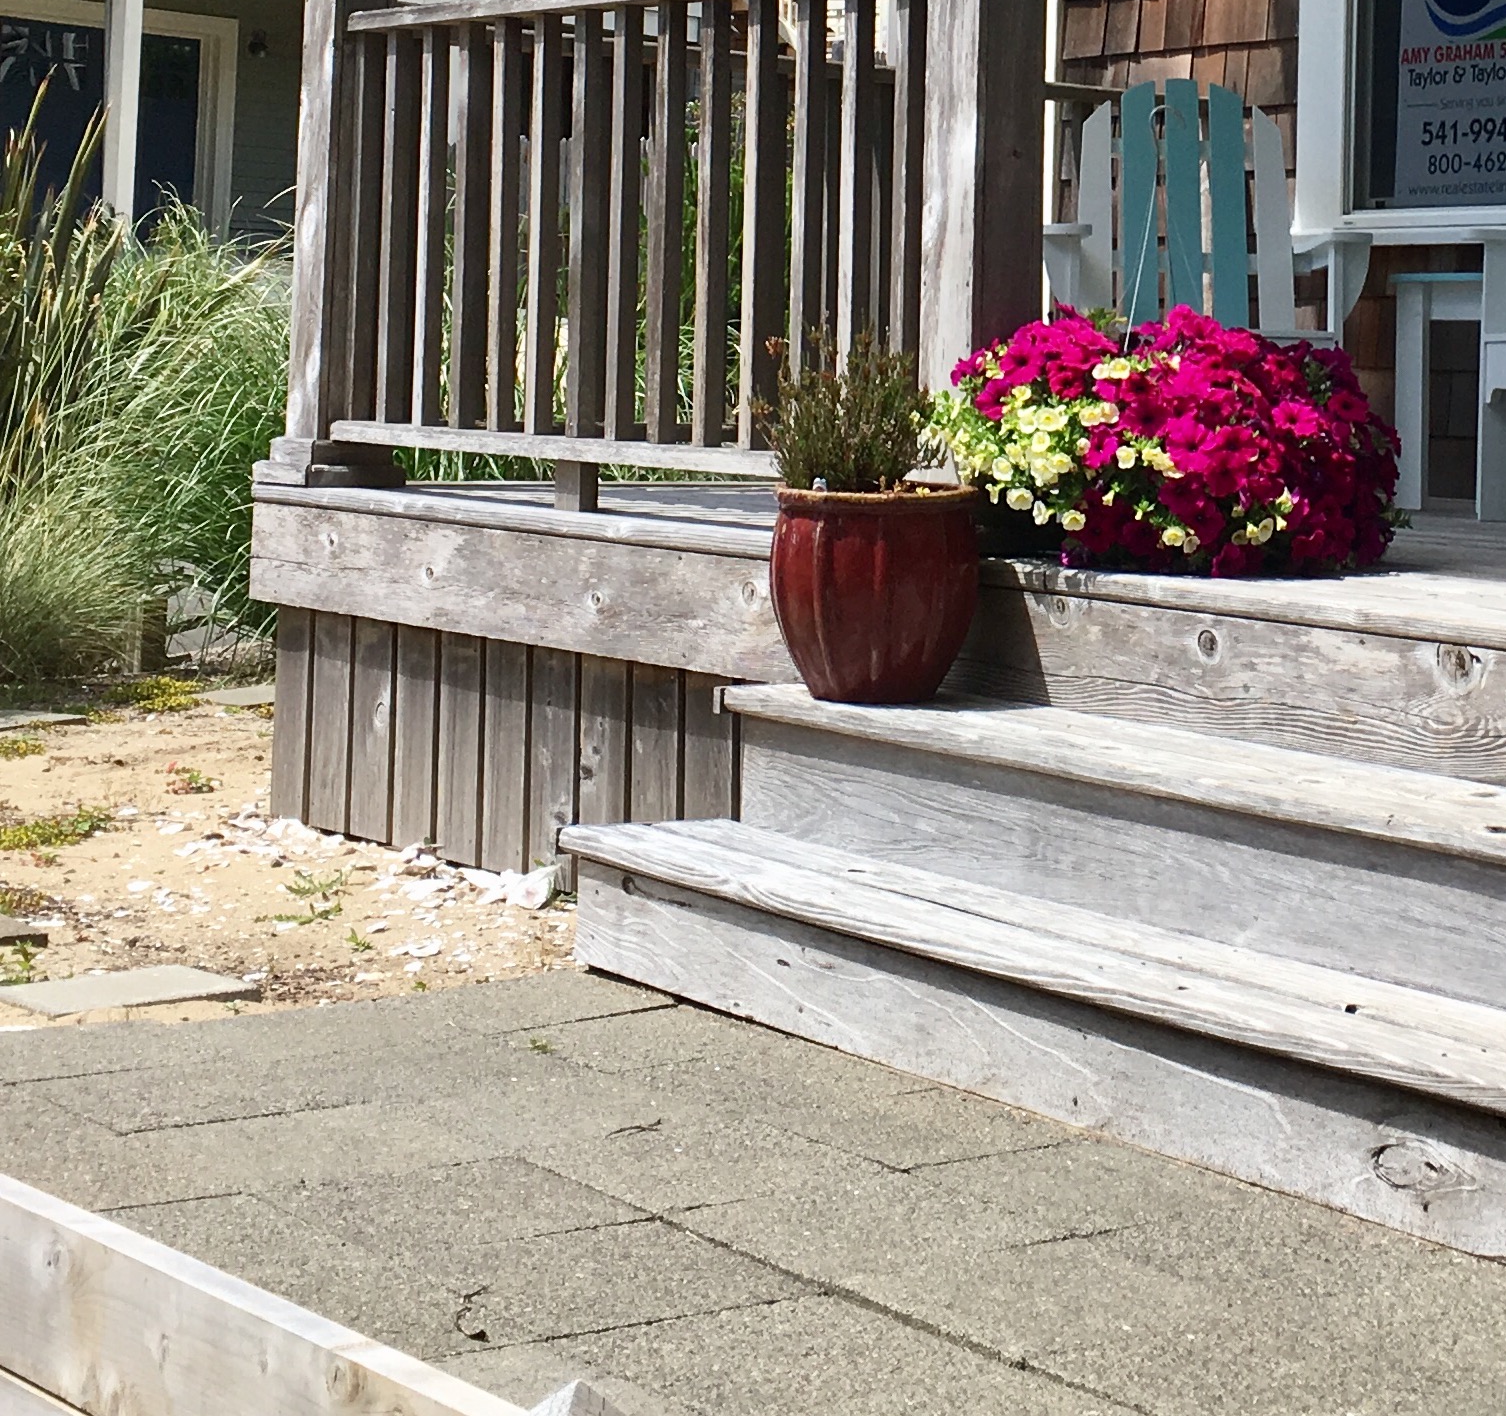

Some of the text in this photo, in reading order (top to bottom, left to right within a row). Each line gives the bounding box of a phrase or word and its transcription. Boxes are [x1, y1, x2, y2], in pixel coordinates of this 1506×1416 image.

[1401, 47, 1430, 65] AMY
[1433, 42, 1495, 63] GRAHAM
[1407, 67, 1449, 90] Taylor
[1452, 66, 1467, 84] &
[1475, 97, 1495, 109] you
